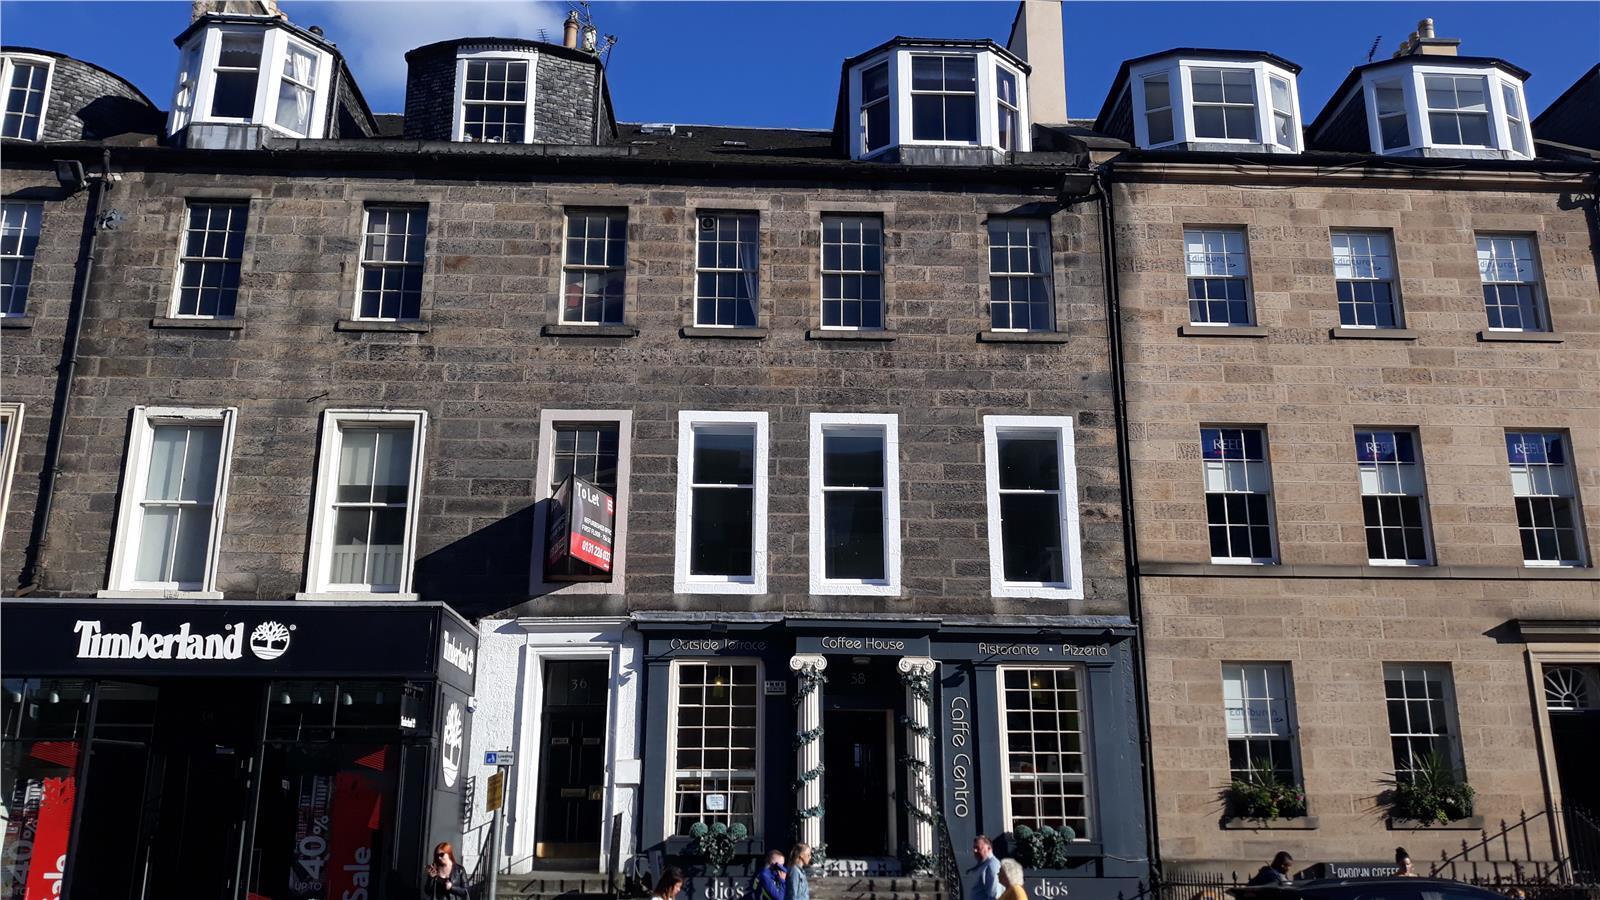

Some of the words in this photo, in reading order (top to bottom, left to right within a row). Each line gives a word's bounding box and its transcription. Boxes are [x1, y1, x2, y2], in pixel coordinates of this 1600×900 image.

[576, 482, 587, 499] To
[588, 488, 600, 507] Let
[73, 620, 245, 660] Timberland
[670, 638, 719, 650] Outside
[724, 639, 766, 650] Terrace
[821, 636, 862, 649] Coffee
[865, 638, 905, 650] House
[978, 642, 1040, 656] Ristorante
[1062, 643, 1108, 656] Pizzeria
[569, 678, 589, 690] 36
[951, 696, 970, 748] Caffe
[953, 753, 971, 818] Centro
[298, 815, 329, 880] 40%
